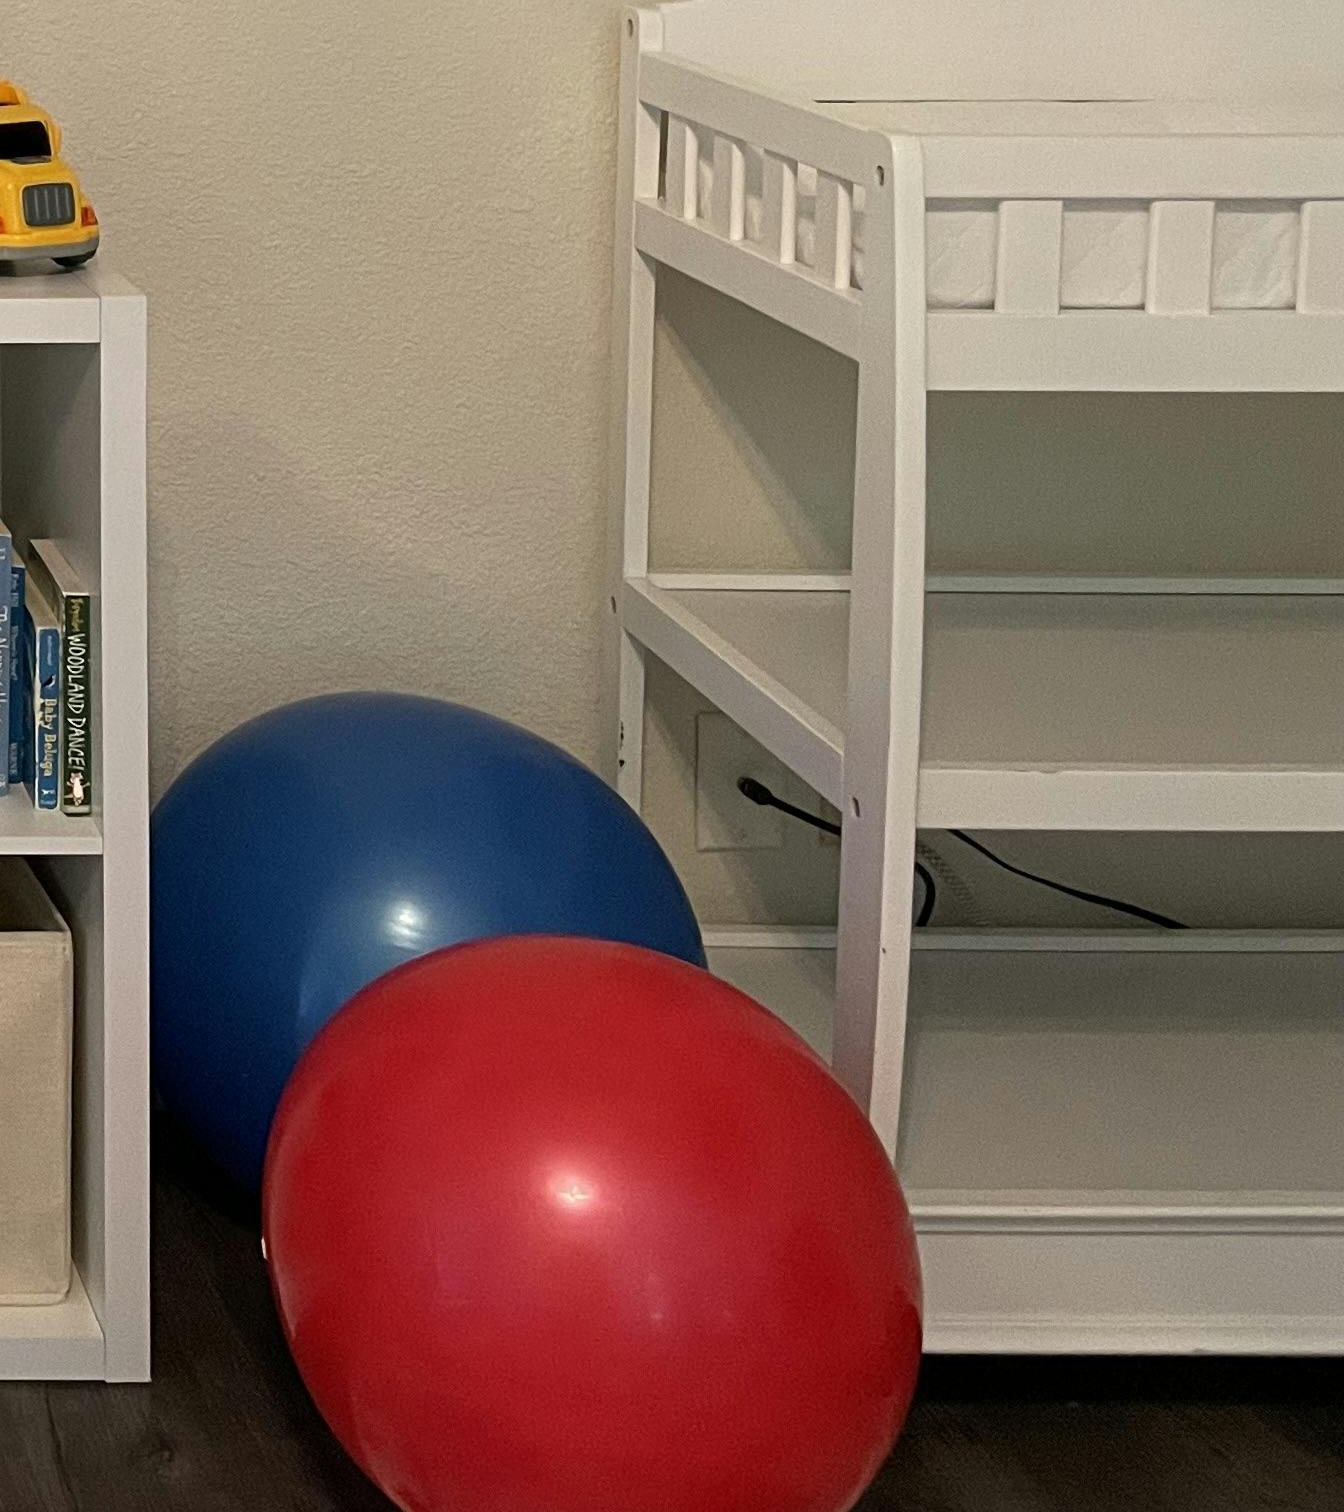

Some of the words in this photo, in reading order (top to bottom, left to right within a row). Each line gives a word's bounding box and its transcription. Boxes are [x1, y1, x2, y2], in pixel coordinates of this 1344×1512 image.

[67, 633, 87, 714] WOODLAND
[41, 698, 57, 729] Baby
[41, 733, 56, 777] Beluga
[67, 717, 86, 770] DANCE!
